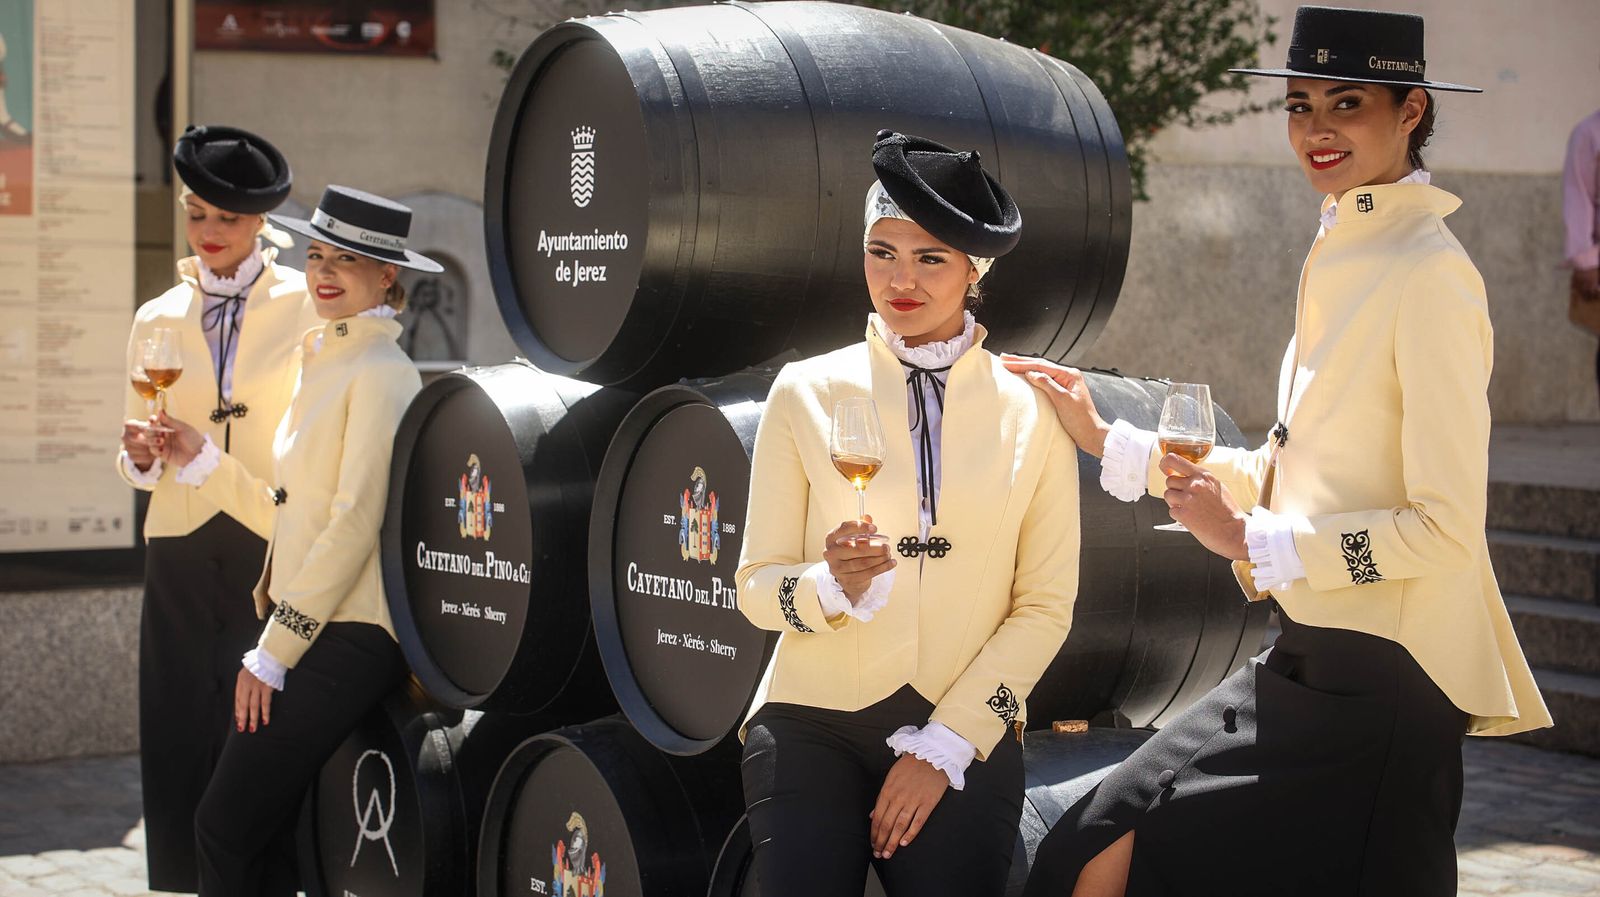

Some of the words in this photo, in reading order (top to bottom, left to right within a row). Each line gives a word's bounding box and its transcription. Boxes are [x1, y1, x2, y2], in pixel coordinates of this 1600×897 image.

[1368, 55, 1408, 71] CAYETANO
[537, 228, 628, 258] Ayuntamiento
[555, 260, 571, 282] de
[572, 260, 607, 287] Jerez
[663, 514, 677, 526] EST.
[722, 522, 736, 534] 1886
[416, 540, 471, 575] CAYETANO
[471, 562, 485, 577] DEL
[485, 550, 513, 581] PINO
[512, 568, 519, 582] &
[627, 561, 693, 602] CAYETANO
[695, 588, 710, 605] DEL
[441, 599, 458, 615] Jerez
[484, 605, 508, 625] Sherry
[657, 628, 678, 646] Jerez
[709, 639, 737, 660] Sherry
[530, 877, 548, 895] EST.
